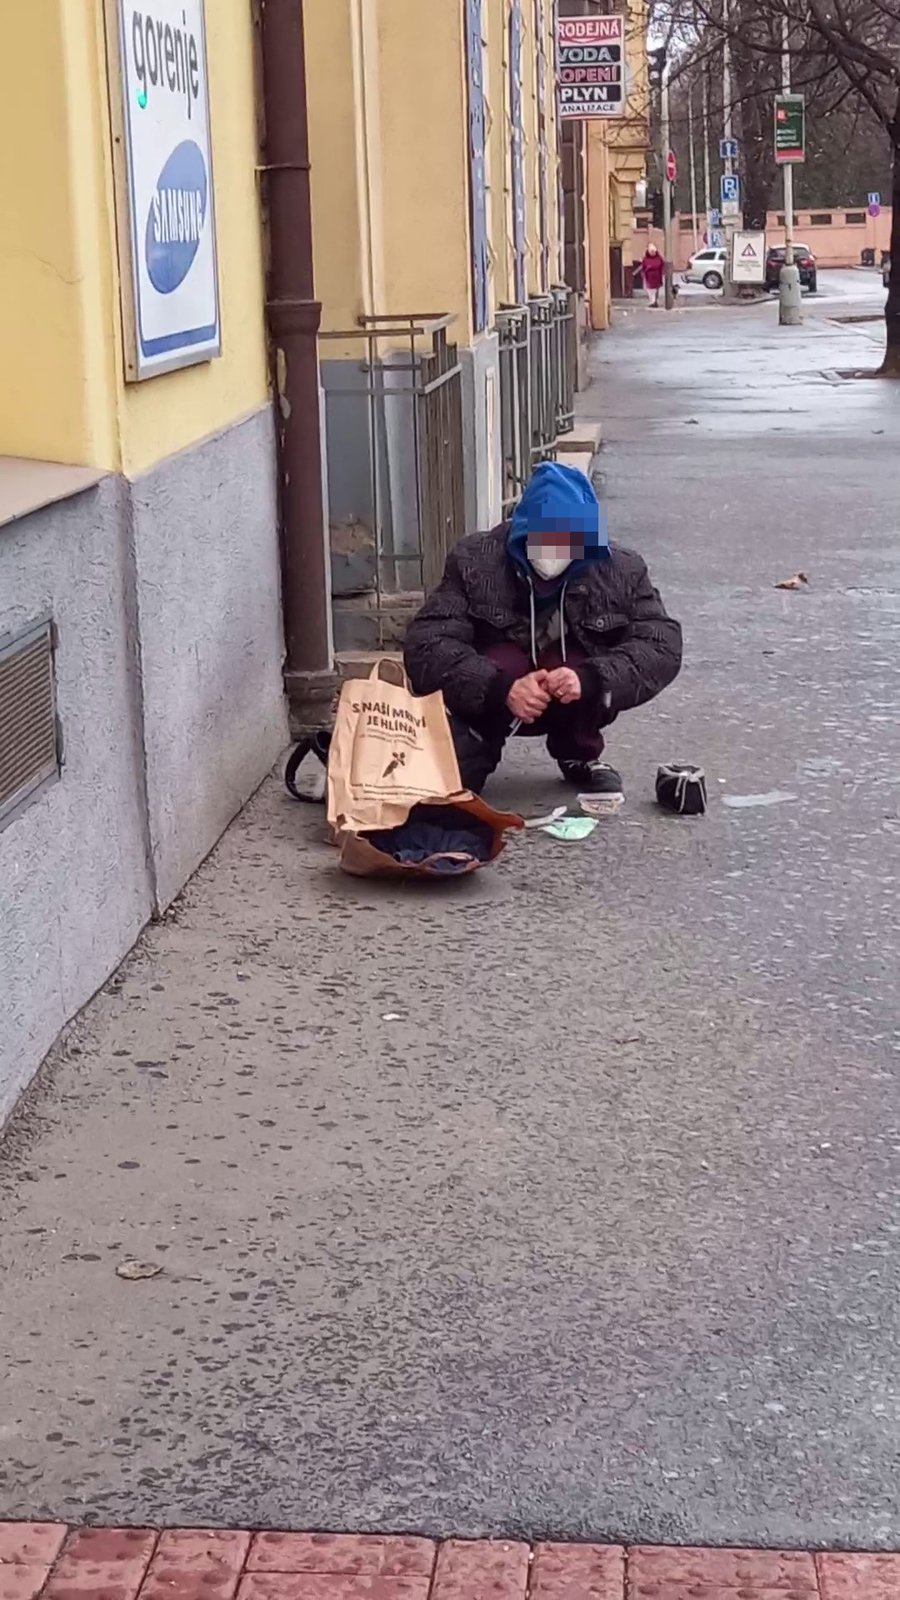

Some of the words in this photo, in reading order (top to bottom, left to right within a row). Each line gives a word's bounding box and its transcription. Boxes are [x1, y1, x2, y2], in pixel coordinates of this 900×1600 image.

[559, 19, 619, 37] RODEJNA
[132, 9, 199, 120] gorenje
[562, 65, 617, 82] OPENÍ
[561, 87, 608, 102] PLYN
[561, 104, 616, 112] ANALIZACE
[153, 188, 203, 243] SAMSUNG
[352, 703, 361, 713] S
